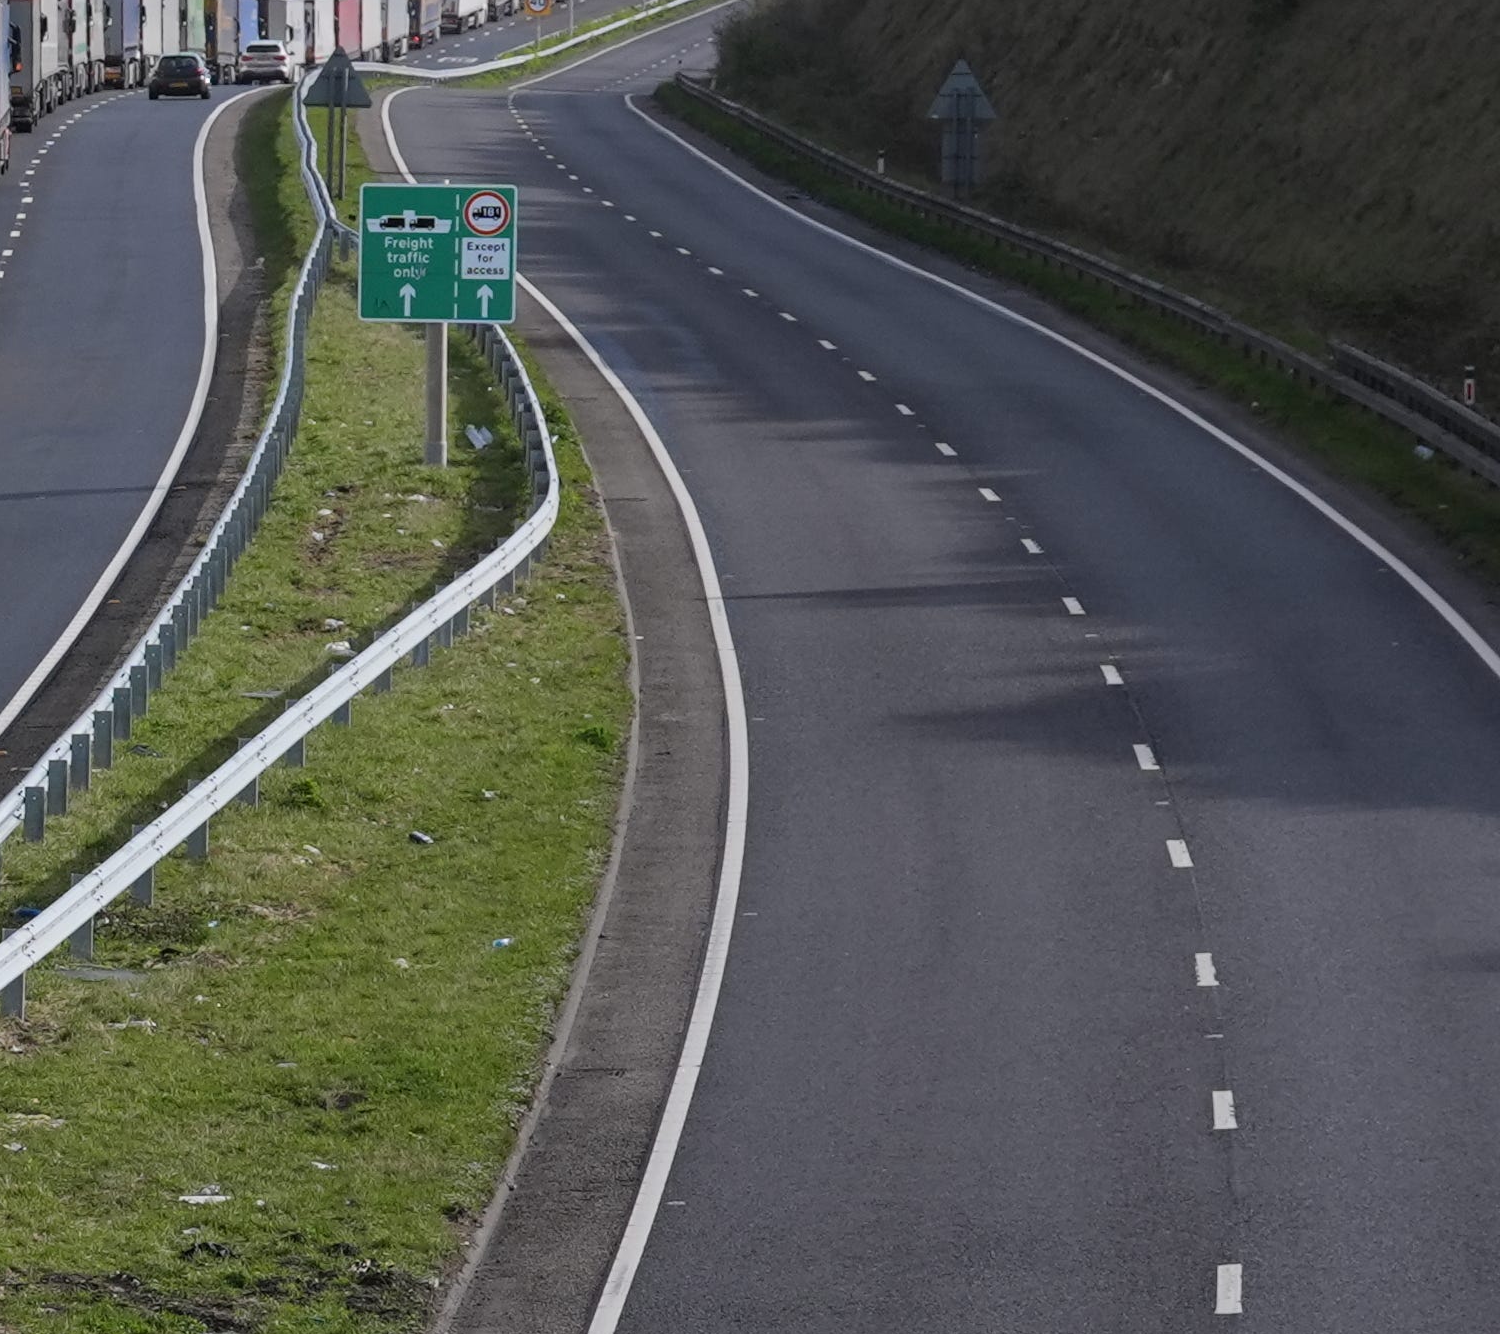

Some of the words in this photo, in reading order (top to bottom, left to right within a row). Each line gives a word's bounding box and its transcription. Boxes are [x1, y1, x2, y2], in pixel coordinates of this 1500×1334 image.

[384, 236, 434, 250] Freight
[466, 242, 506, 253] Except
[387, 251, 430, 264] traffic
[477, 253, 493, 263] for
[393, 266, 426, 280] only
[466, 267, 505, 275] access
